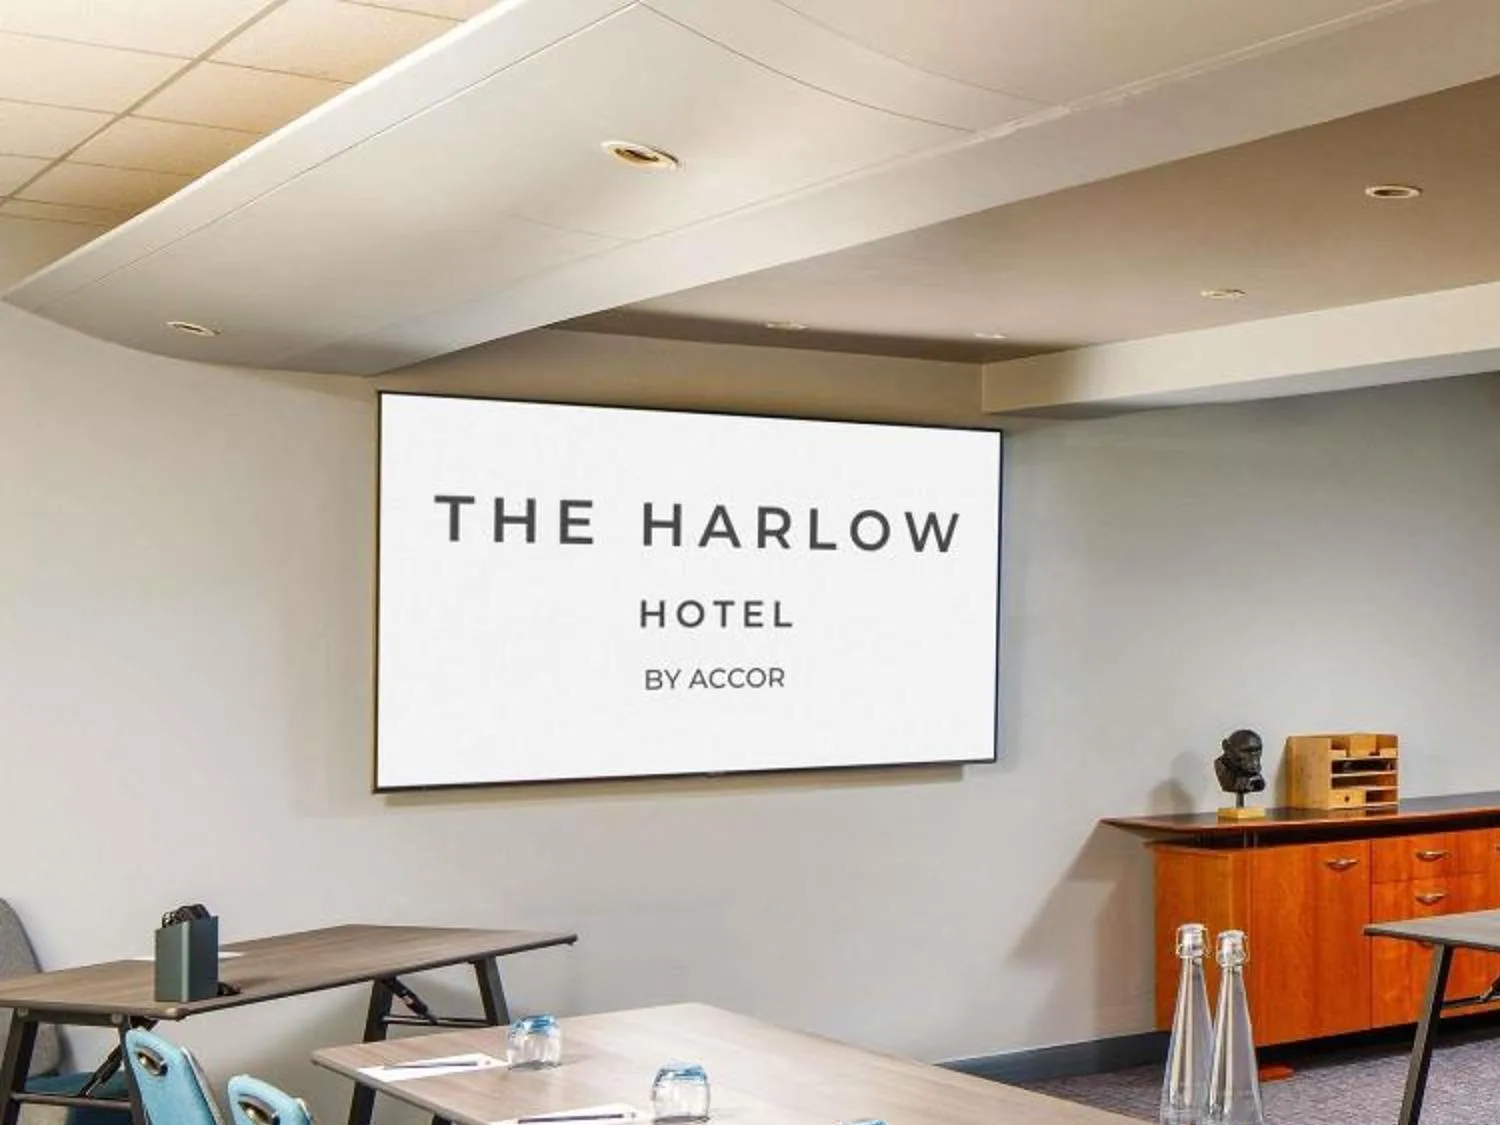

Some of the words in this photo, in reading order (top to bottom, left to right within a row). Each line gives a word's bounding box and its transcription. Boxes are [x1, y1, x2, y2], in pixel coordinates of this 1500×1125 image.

[433, 495, 595, 545] THE
[643, 502, 960, 553] HARLOW
[640, 599, 793, 629] HOTEL
[645, 668, 682, 691] BY
[689, 667, 785, 690] ACCOR
